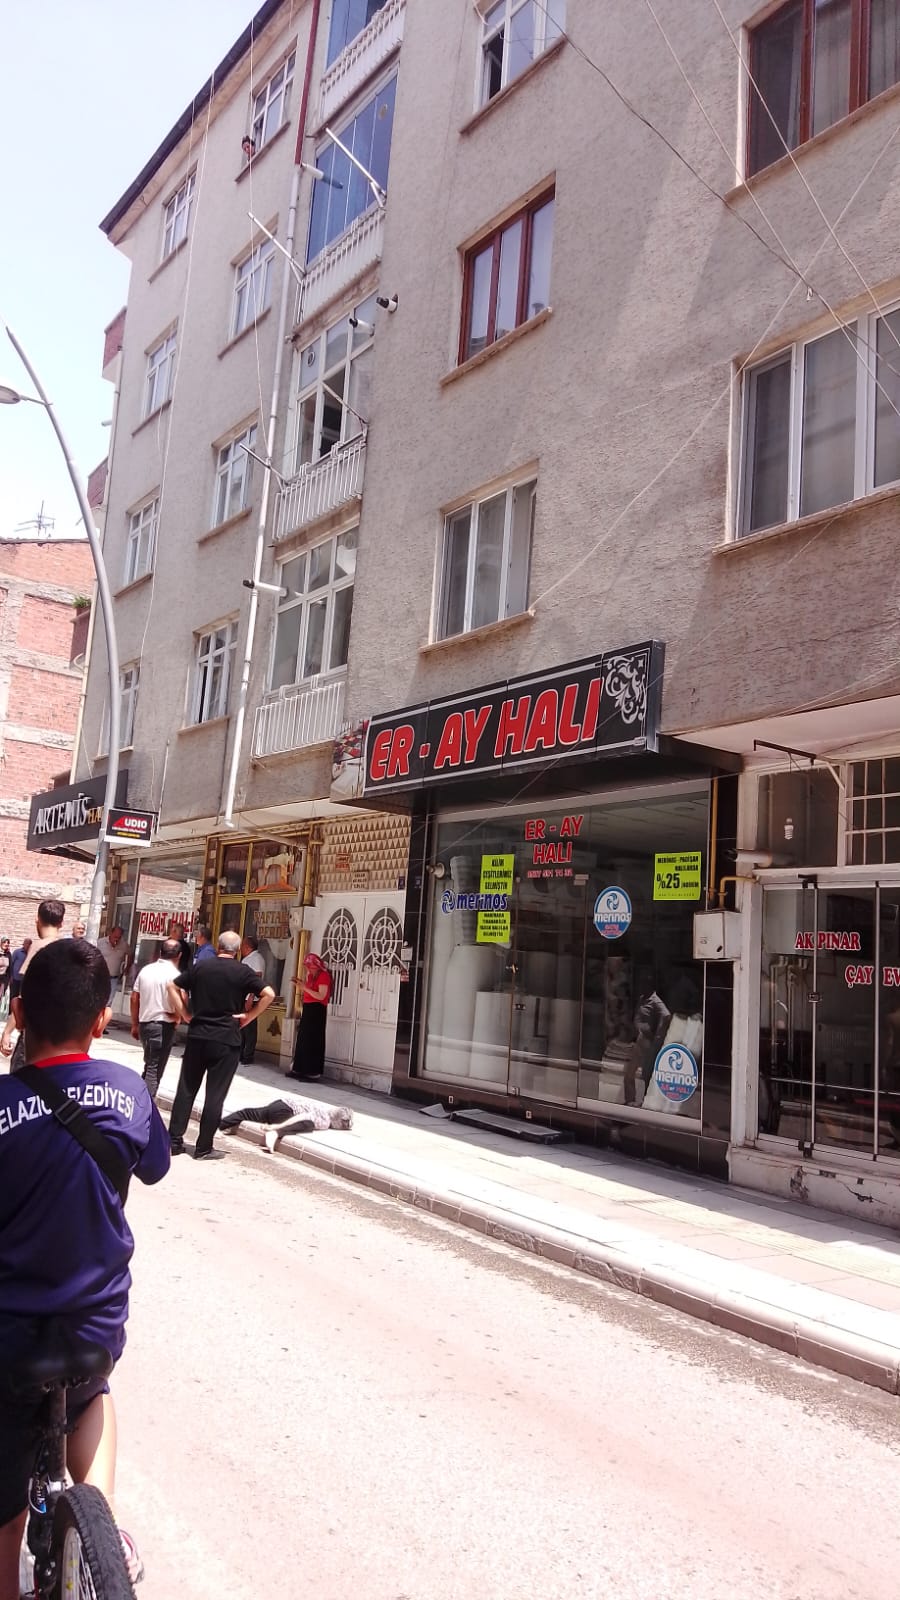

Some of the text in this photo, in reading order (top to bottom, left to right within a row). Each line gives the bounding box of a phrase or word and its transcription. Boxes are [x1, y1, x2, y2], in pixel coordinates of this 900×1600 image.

[370, 724, 414, 781] ER
[434, 705, 493, 770] AY
[494, 678, 602, 759] HALI
[32, 793, 91, 835] ARTEMİS
[525, 819, 546, 841] ER
[560, 815, 584, 837] AY
[533, 842, 573, 865] HALI
[656, 873, 680, 890] %25
[456, 893, 508, 910] merinos
[139, 912, 168, 933] FIRAT
[594, 912, 632, 923] merinos
[845, 965, 874, 988] ÇAY
[655, 1070, 698, 1087] merinos
[62, 1081, 135, 1121] ELEDİYESİ
